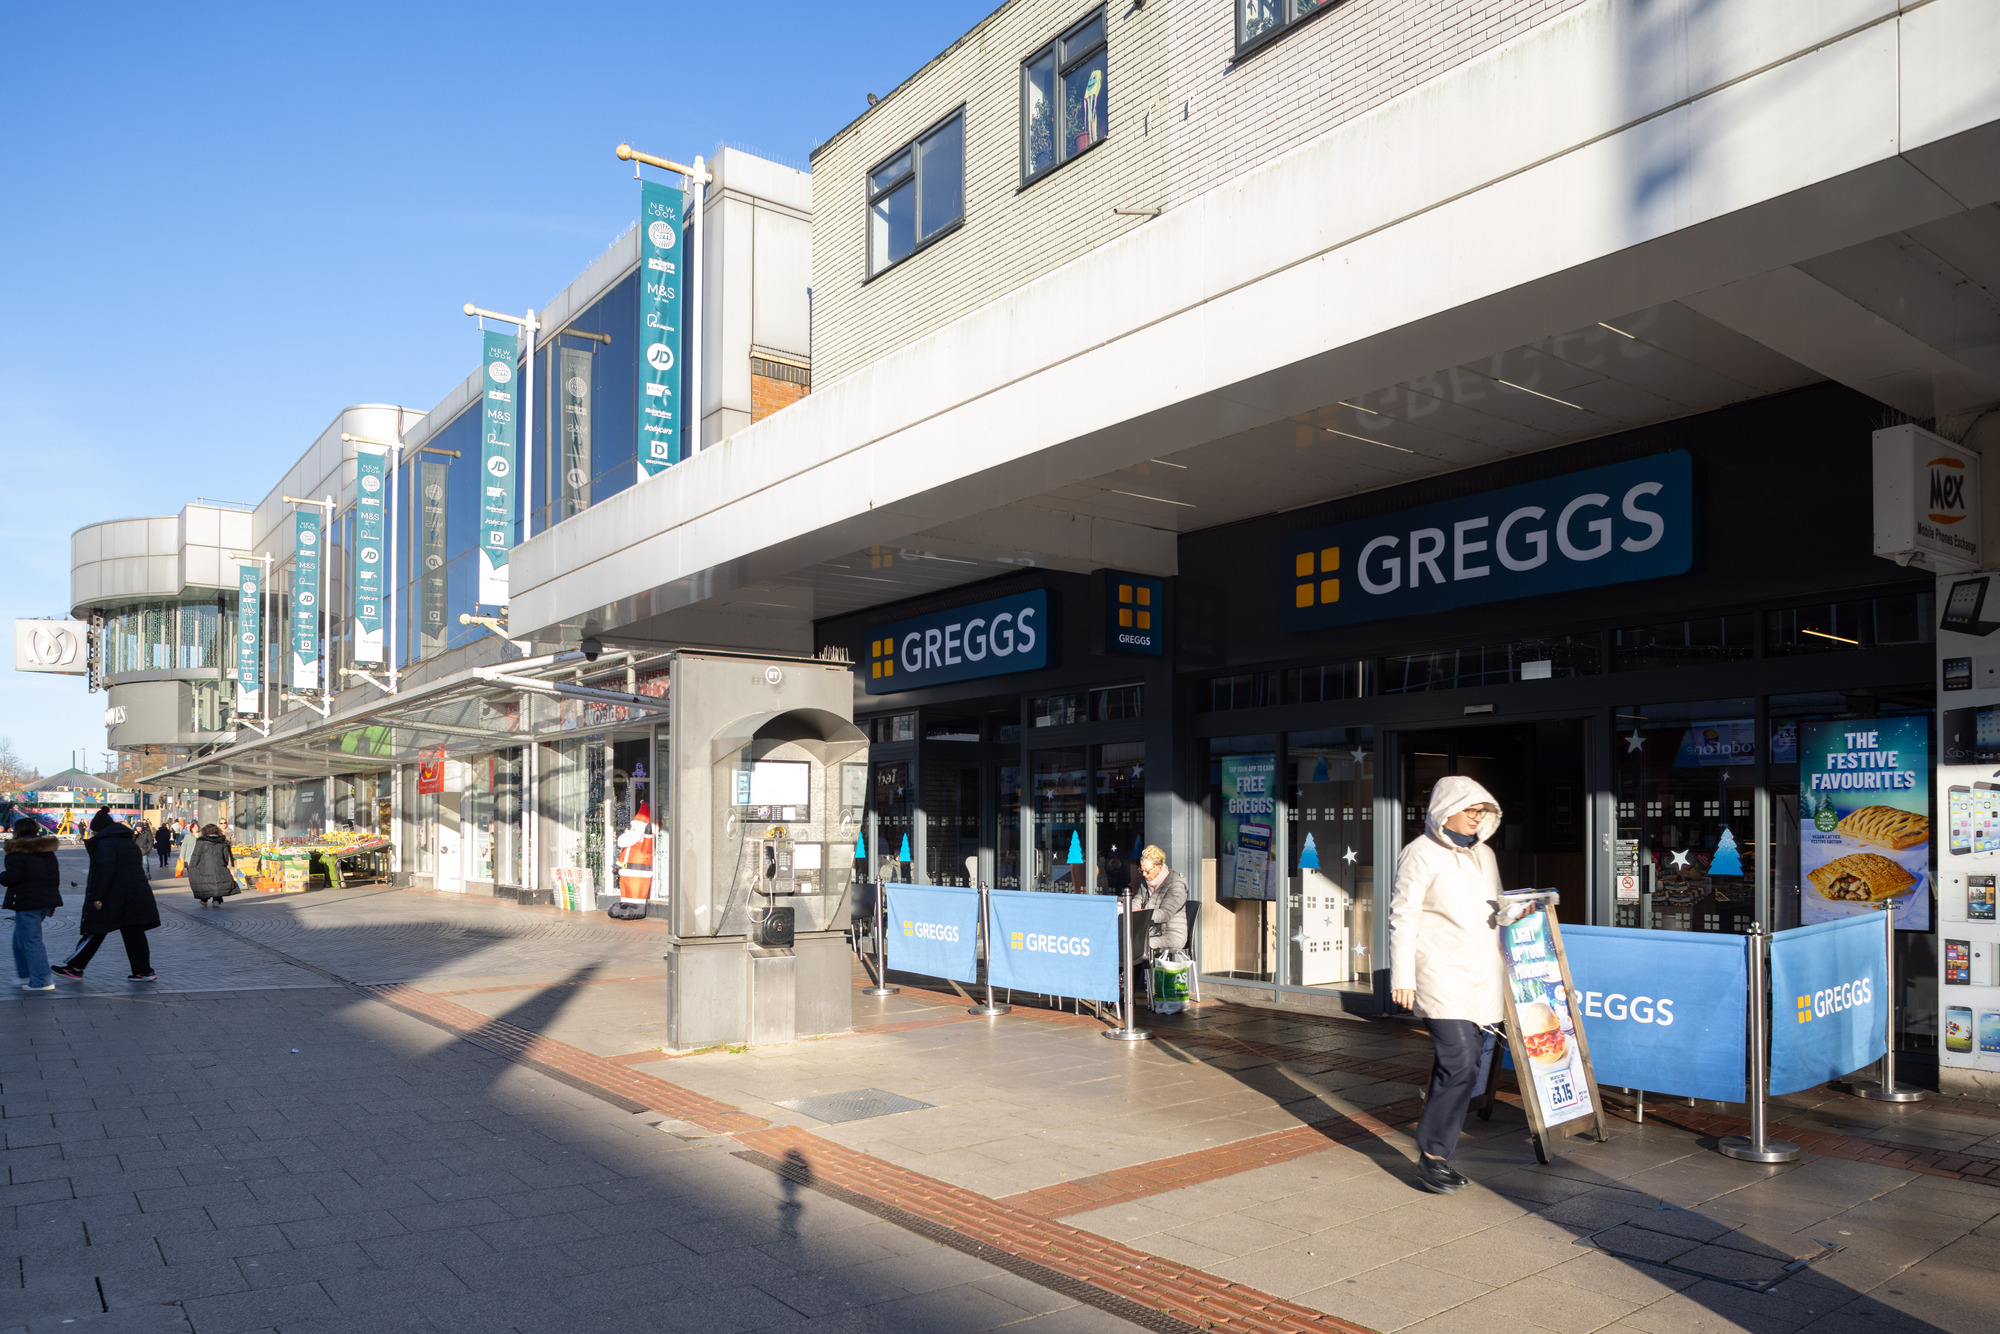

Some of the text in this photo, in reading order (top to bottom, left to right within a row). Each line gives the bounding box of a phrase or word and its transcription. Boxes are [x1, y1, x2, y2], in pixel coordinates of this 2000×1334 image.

[648, 208, 676, 220] LOOK
[650, 202, 674, 213] NEW
[647, 282, 675, 299] M&S
[489, 352, 512, 360] LOOK
[490, 346, 511, 356] NEW
[651, 350, 670, 363] JD
[487, 409, 511, 421] M&S
[490, 461, 507, 472] JD
[1930, 468, 1966, 510] Mex
[361, 512, 380, 520] M&S
[1357, 481, 1665, 595] GREGGS
[1917, 521, 1977, 555] Mobile Phones Exchange
[364, 551, 376, 560] JD
[901, 607, 1036, 673] GREGGS
[1118, 633, 1151, 646] GREGGS
[768, 671, 779, 679] BT
[584, 704, 616, 725] World
[1844, 731, 1879, 749] THE
[1826, 750, 1899, 770] FESTIVE
[1236, 776, 1265, 792] FREE
[1811, 770, 1916, 790] FAVOURITES
[1228, 797, 1274, 814] GREGGS
[914, 921, 959, 943] GREGGS
[1511, 928, 1536, 944] LIGHT
[1026, 932, 1090, 957] GREGGS
[1510, 943, 1546, 962] UP YOUR
[1513, 961, 1550, 980] MORNING
[1814, 977, 1872, 1018] GREGGS
[1552, 1082, 1573, 1105] £3.15
